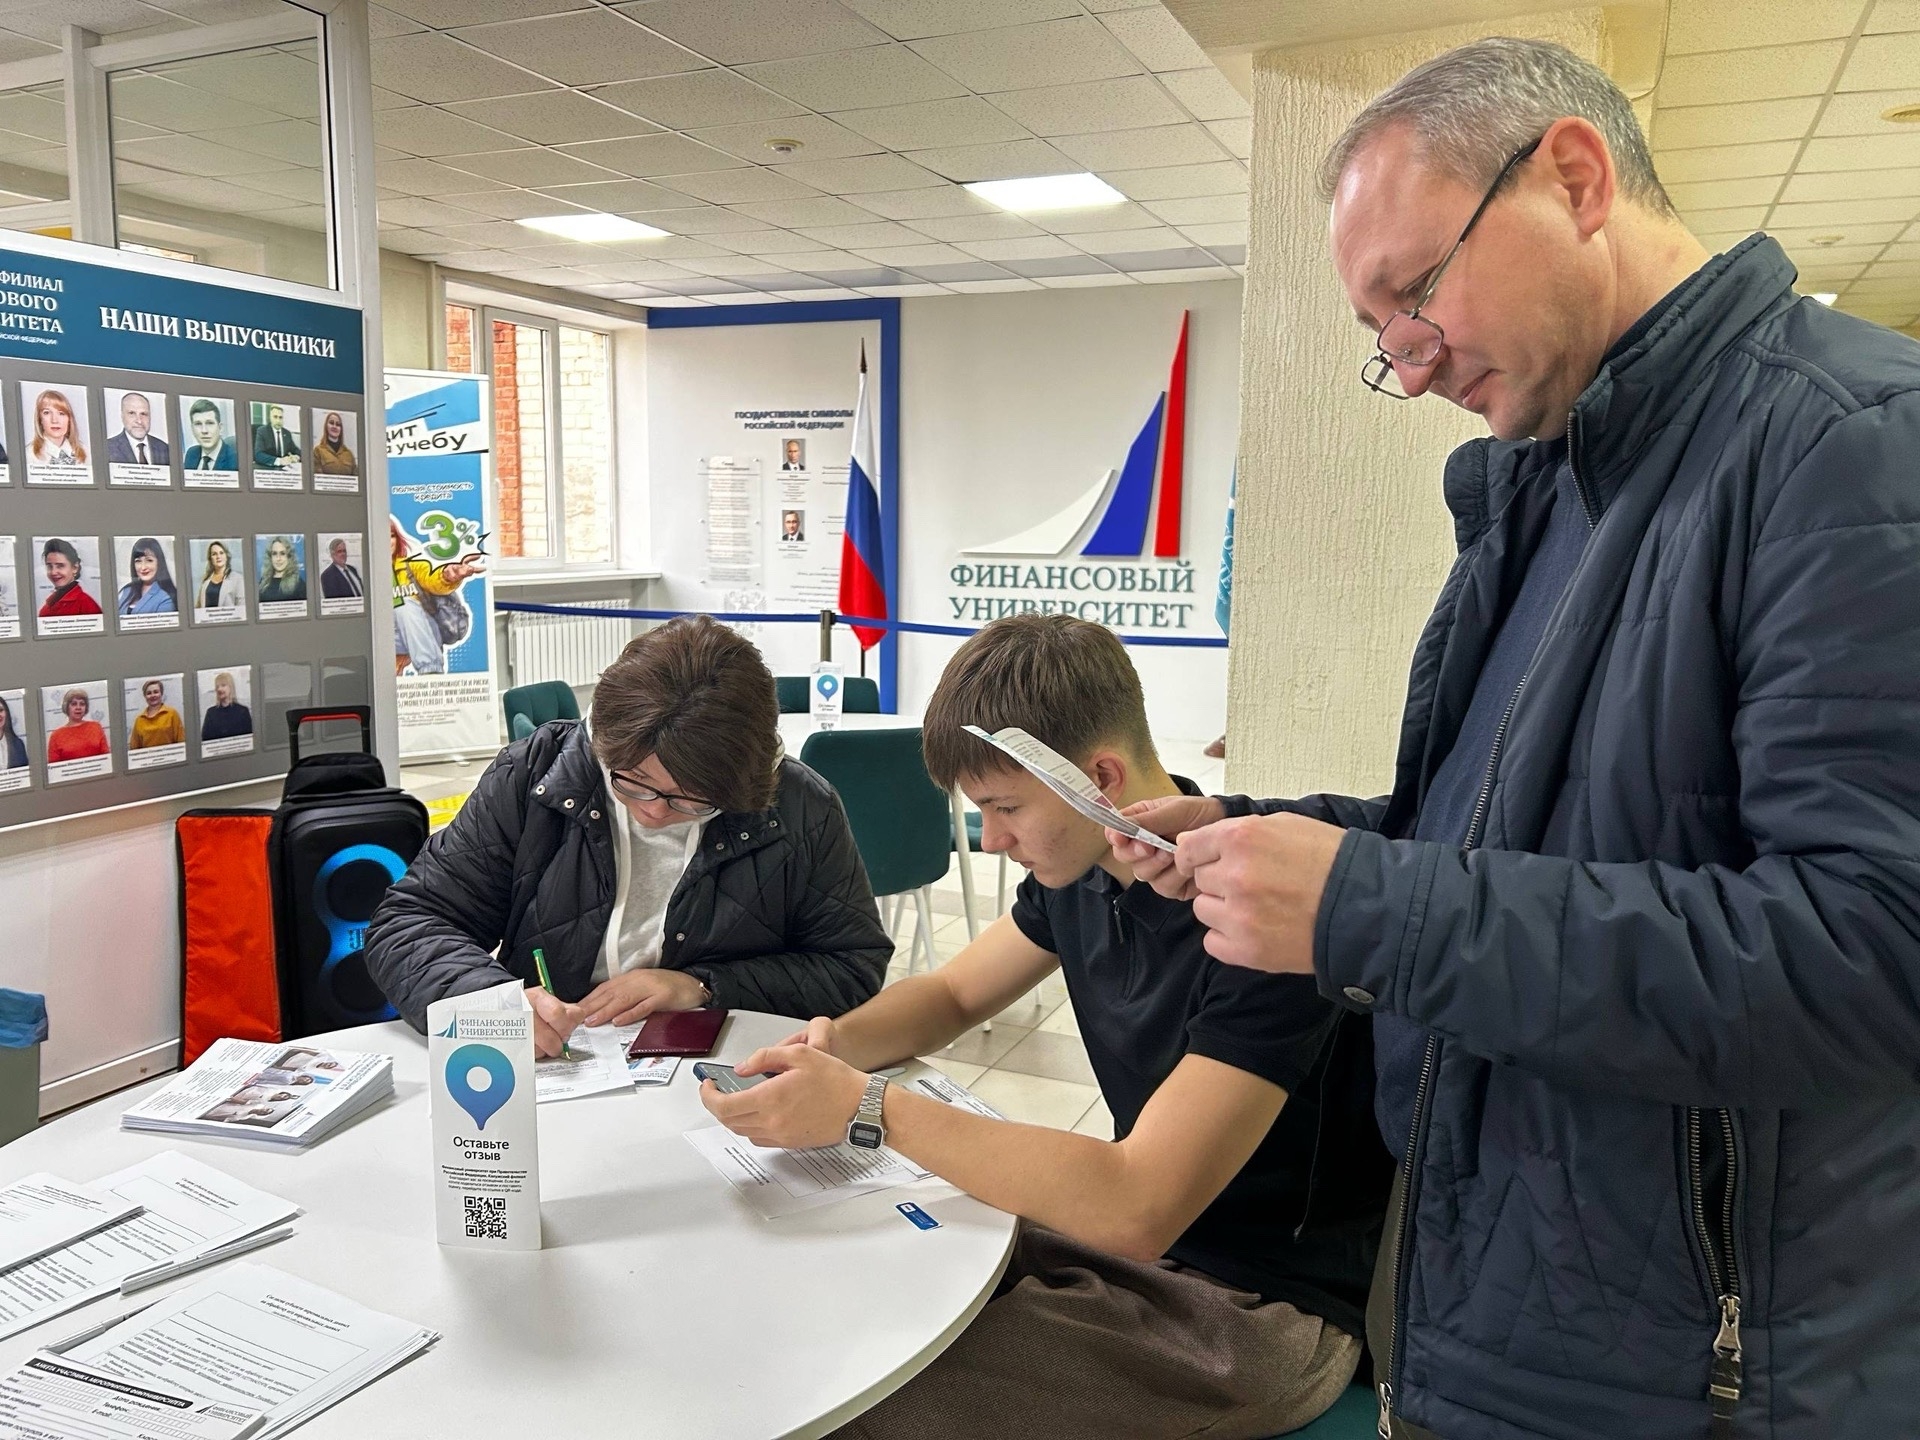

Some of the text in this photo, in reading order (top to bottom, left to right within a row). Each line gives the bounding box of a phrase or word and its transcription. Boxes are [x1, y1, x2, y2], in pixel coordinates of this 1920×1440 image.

[0, 270, 64, 292] ФИЛИАЛ
[0, 312, 64, 334] ИТЕТА
[100, 306, 336, 359] НАШИ ВЫПУСКНИКИ
[735, 409, 854, 420] ГОСУДАРСТВЕННЫЕ СИМВОЛЫ
[744, 420, 845, 430] РОССИЙСКОЙ ФЕДЕРАЦИИ
[396, 431, 468, 455] учебу
[420, 513, 475, 561] 3%
[950, 560, 1195, 594] ФИНАНСОВЫЙ
[459, 1017, 526, 1027] ФИНАНСОВЫЙ
[459, 1027, 527, 1036] УНИВЕРСИТЕТ
[453, 1136, 510, 1150] Оставьте
[464, 1150, 501, 1161] отзыв
